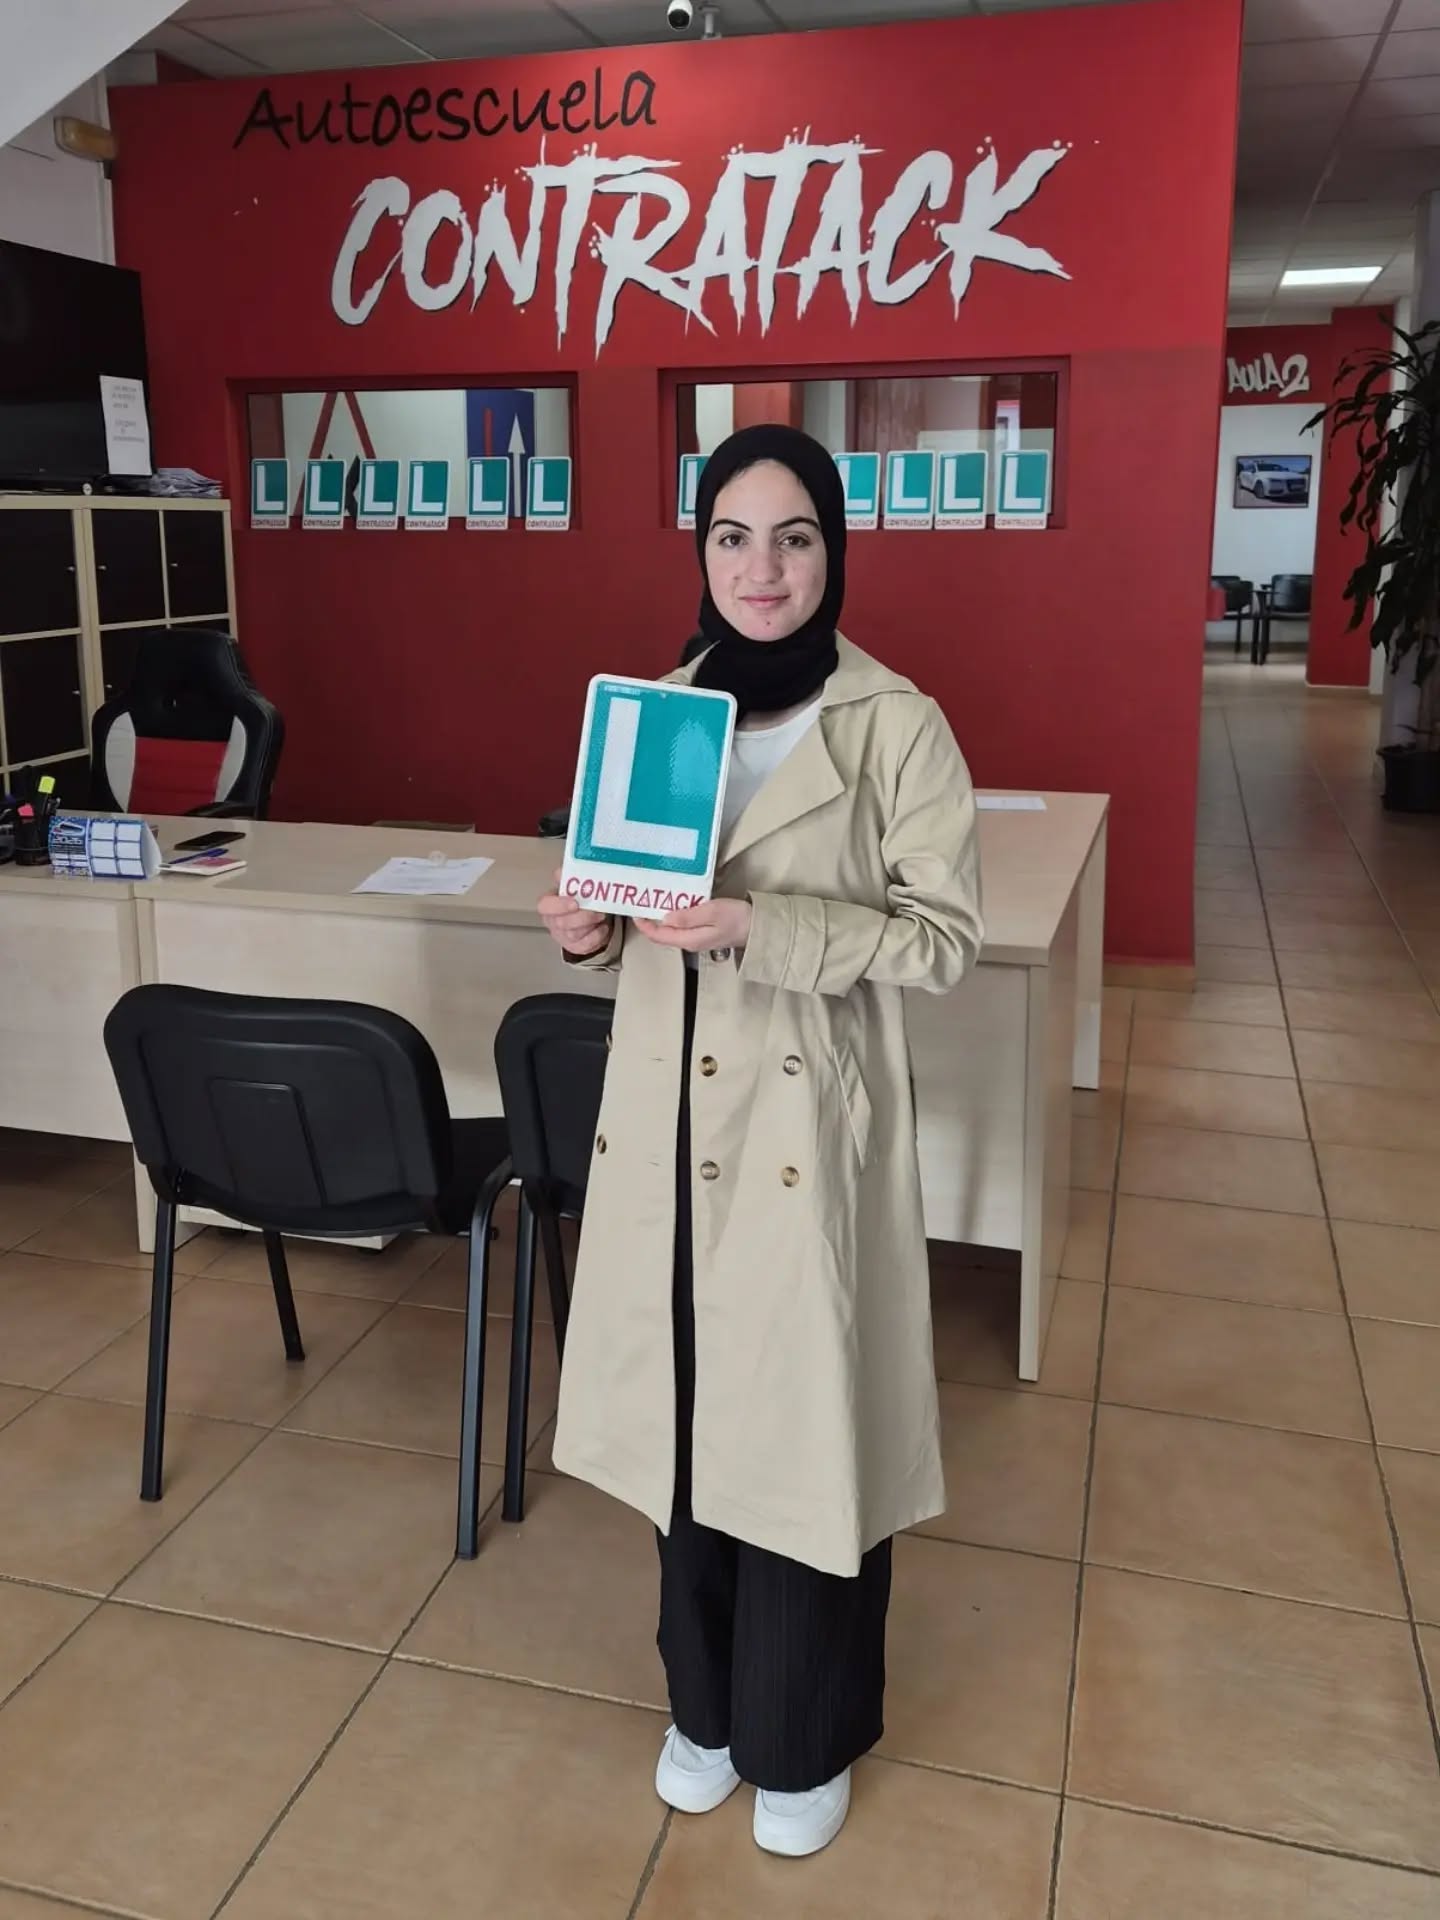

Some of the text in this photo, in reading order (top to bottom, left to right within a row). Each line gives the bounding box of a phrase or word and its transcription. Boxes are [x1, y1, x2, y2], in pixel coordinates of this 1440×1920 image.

[234, 68, 657, 149] Autoescuela
[331, 127, 1073, 361] CONTRATACK
[256, 465, 284, 511] L
[309, 465, 340, 511] L
[363, 465, 394, 512] L
[412, 465, 443, 512] L
[473, 464, 503, 511] L
[533, 463, 565, 511] L
[892, 457, 928, 509] L
[943, 458, 981, 509] L
[1003, 457, 1042, 509] L
[591, 697, 699, 860] L
